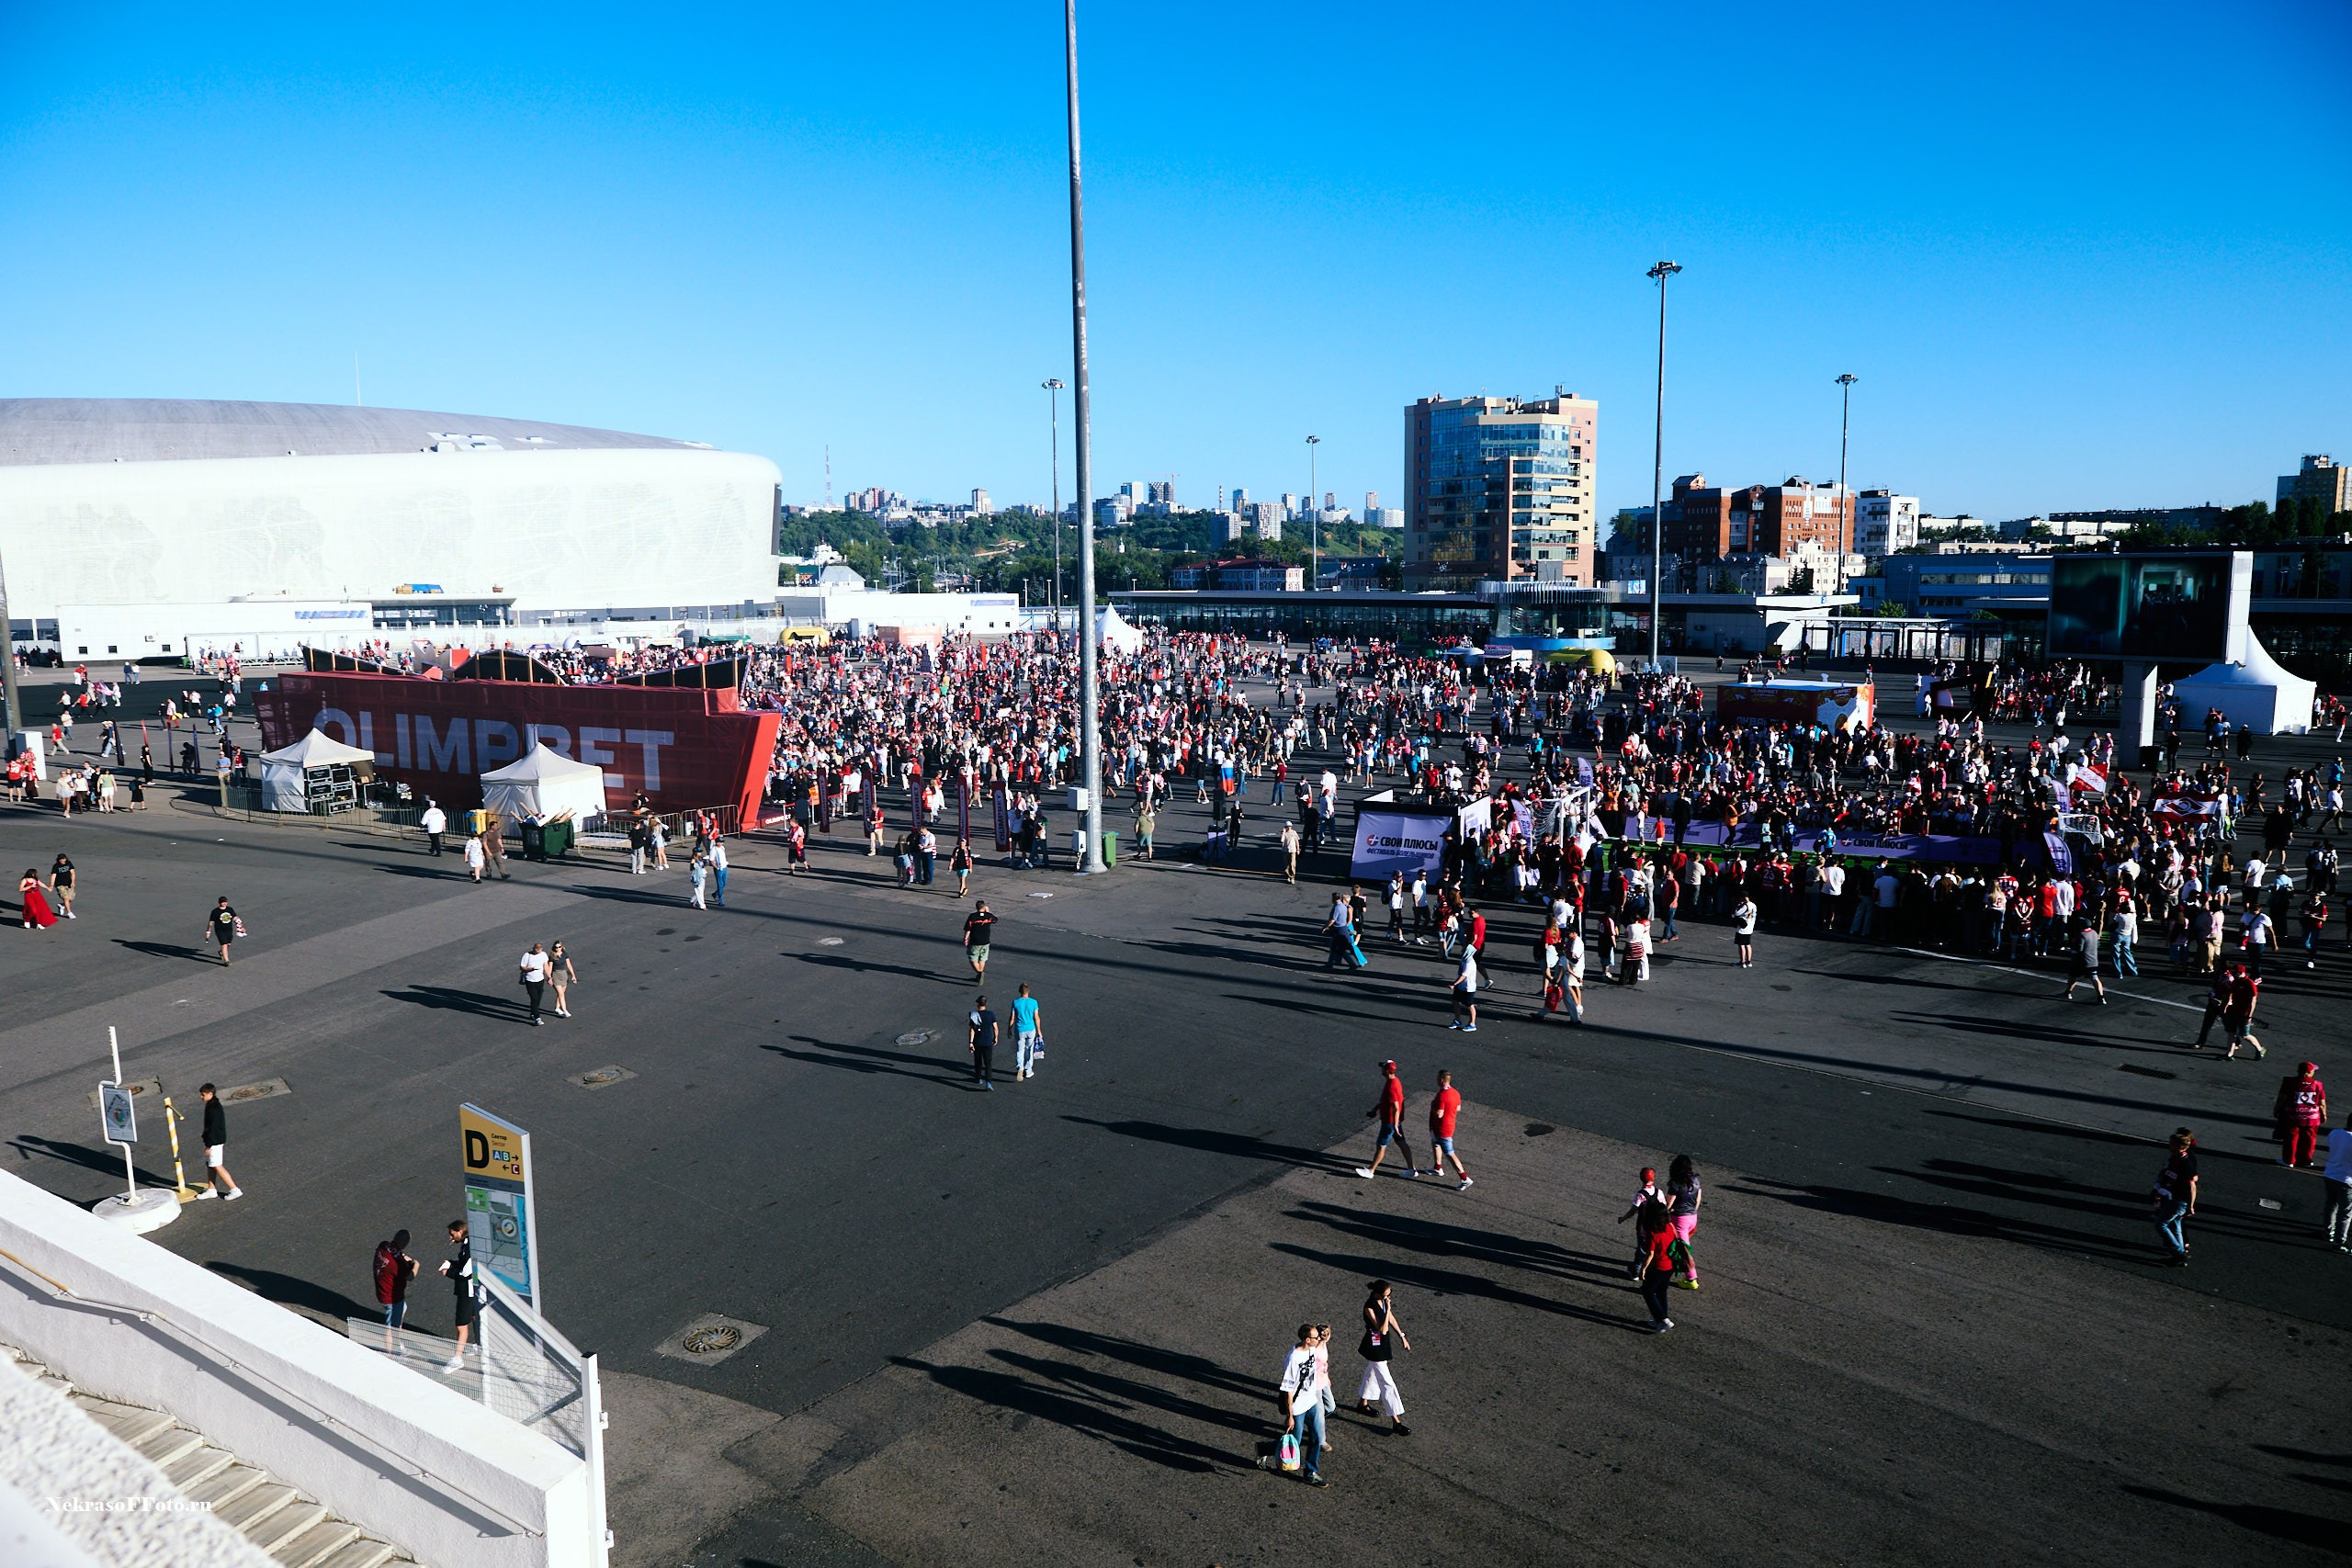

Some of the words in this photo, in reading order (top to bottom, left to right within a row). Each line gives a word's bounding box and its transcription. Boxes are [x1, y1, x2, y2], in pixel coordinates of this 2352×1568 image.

[312, 708, 674, 791] OLIMPBET
[1404, 839, 1438, 851] ПЛЮСЫ
[465, 1130, 489, 1168] D
[512, 1166, 519, 1174] C
